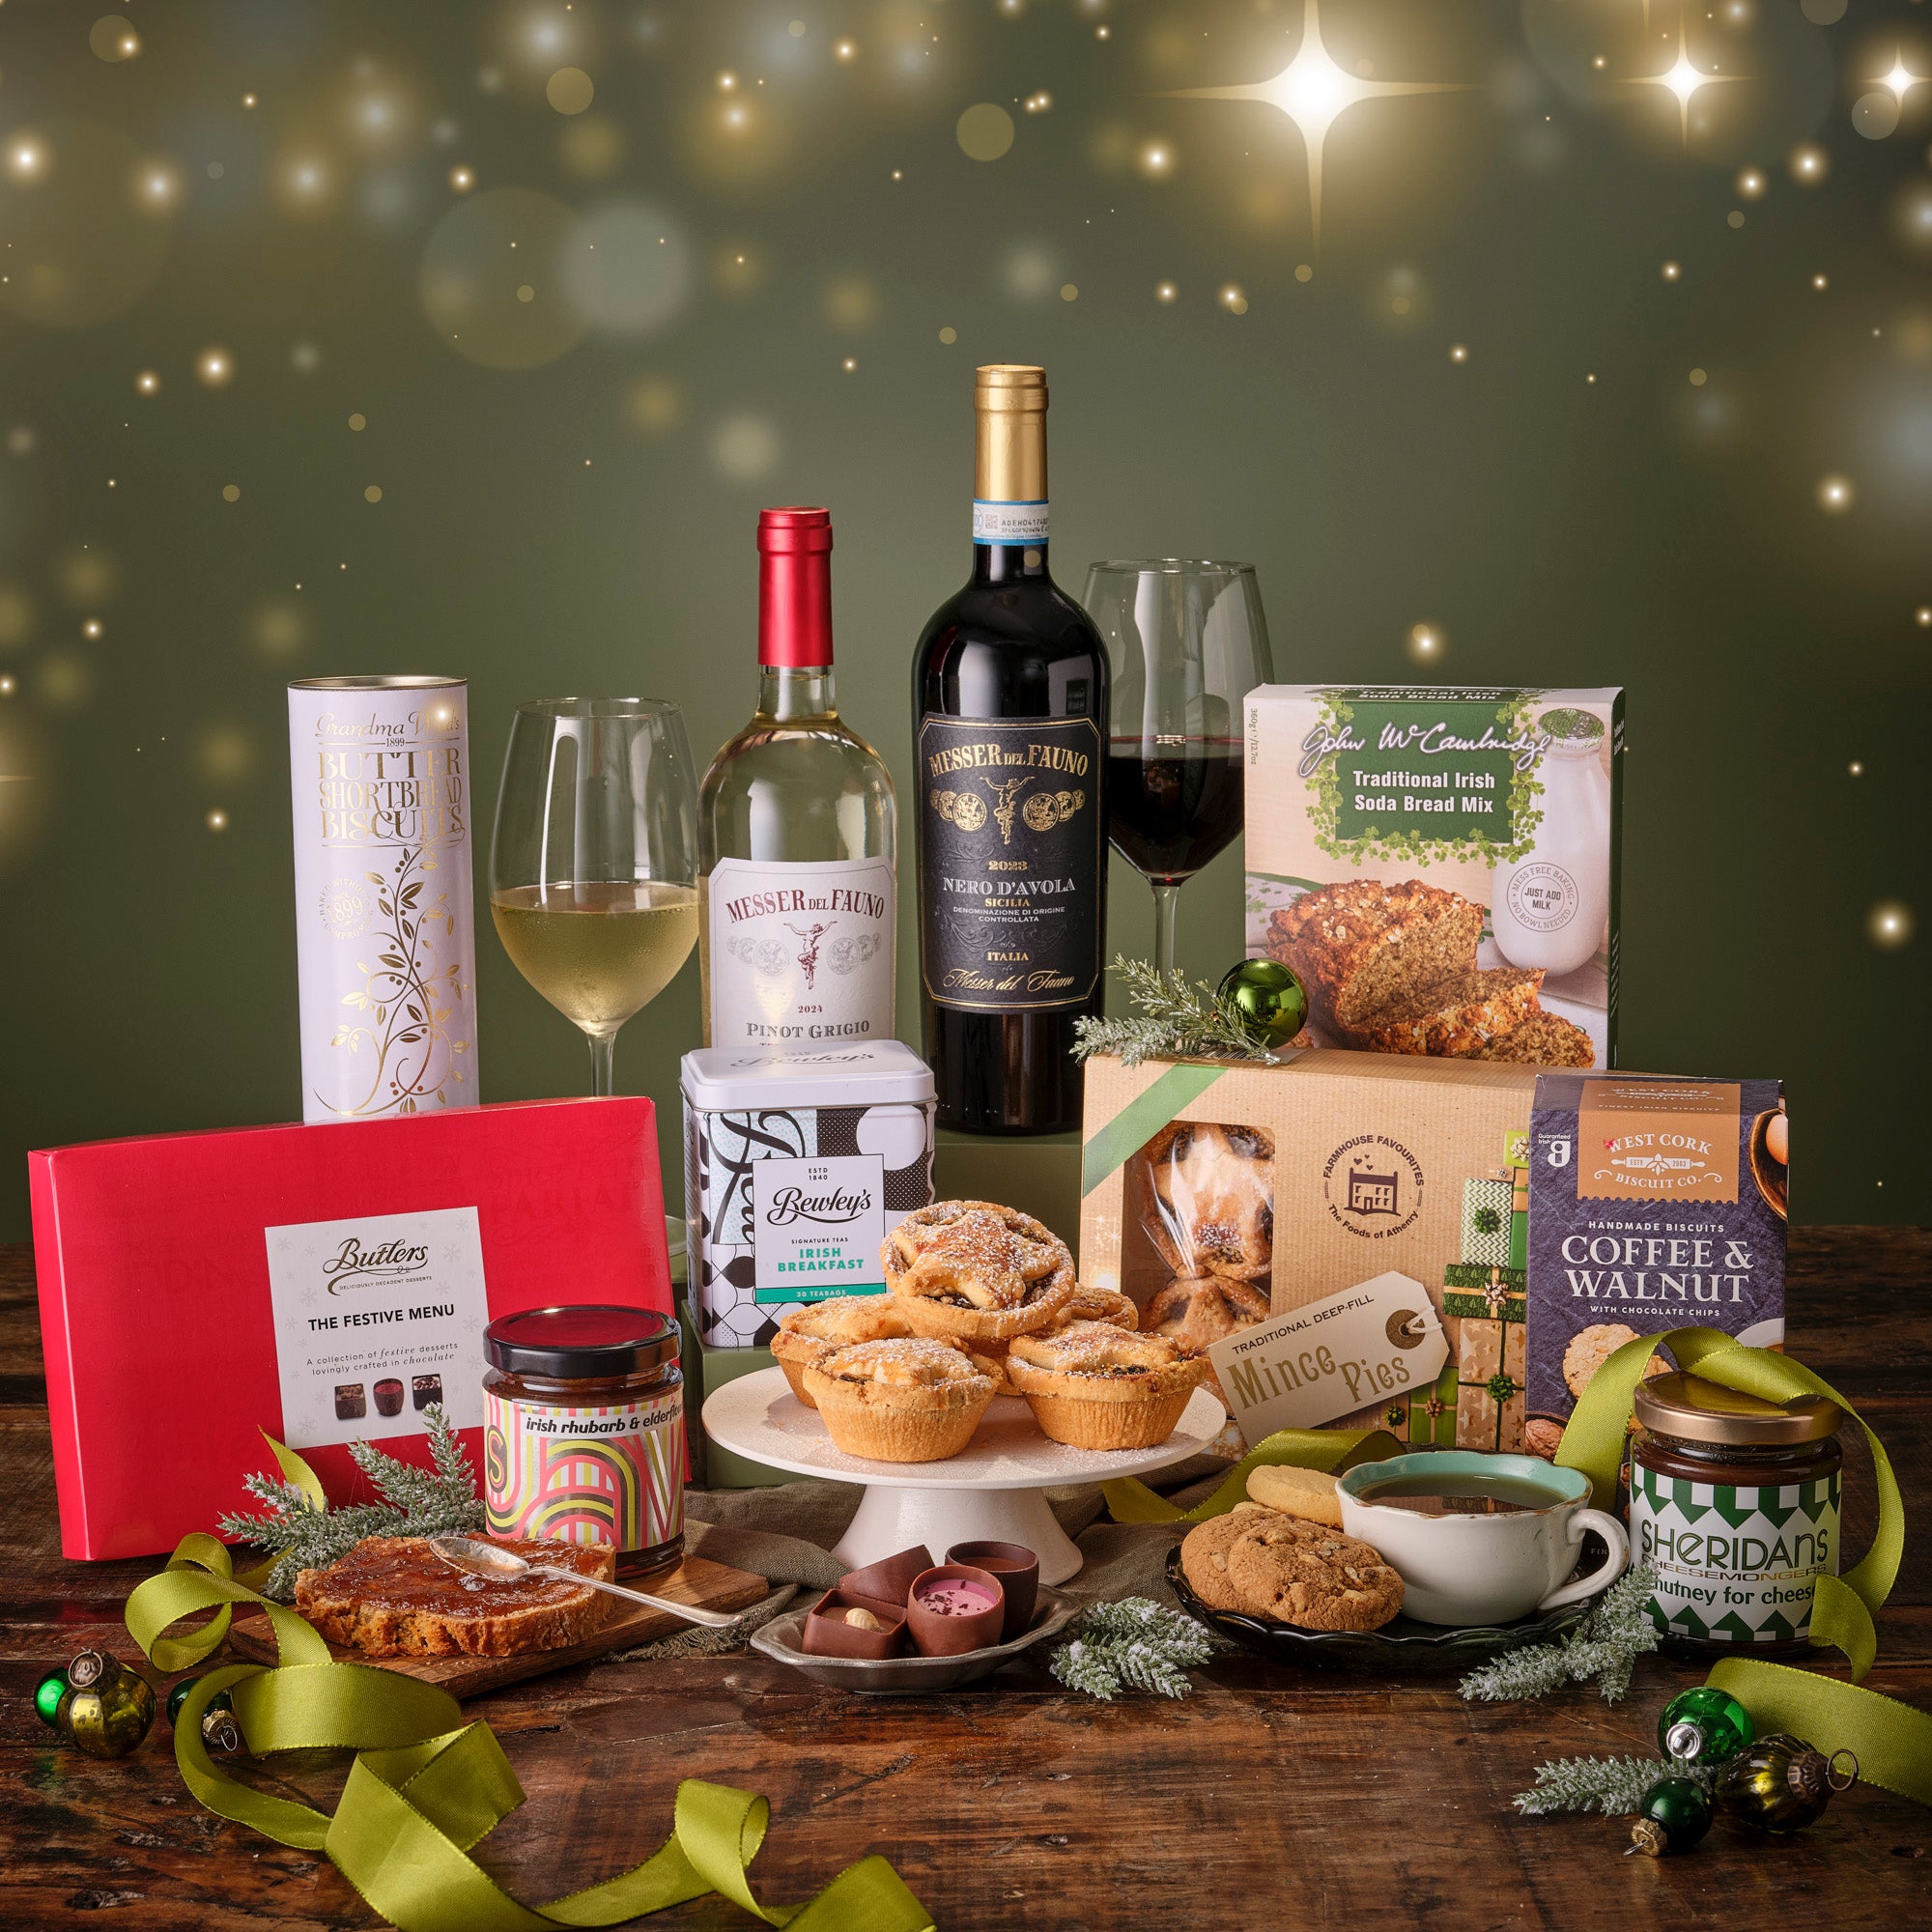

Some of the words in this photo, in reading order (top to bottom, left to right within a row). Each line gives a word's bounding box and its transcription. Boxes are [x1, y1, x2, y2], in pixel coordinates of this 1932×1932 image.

[315, 712, 405, 737] Grandma
[385, 737, 405, 748] 1899
[1299, 724, 1365, 777] John
[318, 748, 461, 780] BUTTER
[928, 743, 1003, 778] MESSER
[1004, 753, 1026, 766] DEL
[1026, 744, 1089, 777] FAUNO
[1352, 770, 1448, 788] Traditional
[1455, 772, 1495, 788] Irish
[319, 777, 462, 811] SHORTBREAD
[1354, 794, 1397, 811] Soda
[1404, 795, 1455, 812] Bread
[1462, 796, 1493, 812] Mix
[321, 806, 466, 840] BISCUITS
[988, 860, 1029, 871] 2023
[943, 877, 993, 895] NERO
[997, 877, 1076, 895] D'AVOLA
[1512, 870, 1529, 892] MESS
[1530, 867, 1552, 875] FREE
[1552, 870, 1575, 899] BAKING
[1524, 887, 1544, 898] JUST
[1546, 890, 1562, 901] ADD
[725, 889, 806, 923] MESSER
[808, 898, 829, 910] DEL
[830, 889, 885, 920] FAUNO
[952, 906, 1020, 916] DENOMINAZIONE
[1022, 907, 1031, 916] DI
[1033, 906, 1065, 915] ORIGINE
[984, 897, 1031, 907] SICILIA
[1532, 899, 1551, 911] MILK
[1512, 901, 1522, 914] NO
[1519, 914, 1543, 928] BOWL
[1543, 908, 1572, 929] NEEDED
[986, 952, 1029, 961] ITALIA
[943, 968, 995, 991] Messer
[995, 975, 1025, 991] del
[1027, 969, 1074, 992] Fauno
[798, 1005, 823, 1013] 2024
[746, 1022, 804, 1038] PINOT
[809, 1020, 870, 1038] GRIGIO
[1605, 1133, 1655, 1153] WEST
[1659, 1133, 1714, 1155] CORK
[1322, 1134, 1375, 1179] FARMHOUSE
[1377, 1135, 1425, 1187] FAVOURITES
[1615, 1172, 1674, 1189] BISCUIT
[766, 1186, 871, 1226] Bewley's
[1328, 1204, 1342, 1222] The
[1342, 1220, 1371, 1238] Foods
[1373, 1230, 1384, 1239] of
[1386, 1209, 1419, 1237] Athenry
[1588, 1220, 1660, 1231] HANDMADE
[1665, 1223, 1724, 1233] BISCUITS
[323, 1237, 428, 1277] Butlers
[799, 1247, 841, 1259] IRISH
[1561, 1236, 1714, 1267] COFFEE
[1724, 1240, 1754, 1269] &
[778, 1259, 864, 1272] BREAKFAST
[339, 1282, 374, 1291] DELICIOUSLY
[406, 1275, 432, 1284] DESSERTS
[1563, 1269, 1749, 1303] WALNUT
[308, 1317, 338, 1331] THE
[343, 1310, 404, 1327] FESTIVE
[409, 1304, 455, 1321] MENU
[1590, 1305, 1617, 1314] WITH
[1622, 1307, 1684, 1316] CHOCOLATE
[1232, 1320, 1312, 1354] TRADITIONAL
[1313, 1294, 1375, 1324] DEEP-FILL
[312, 1365, 350, 1376] lovingly
[354, 1360, 387, 1371] crafted
[403, 1352, 455, 1366] chocolate
[317, 1353, 364, 1365] collection
[380, 1348, 415, 1360] festive
[419, 1343, 458, 1353] desserts
[1225, 1345, 1336, 1409] Mince
[1338, 1356, 1410, 1404] Pies
[526, 1417, 557, 1433] irish
[560, 1418, 626, 1434] rhubarb
[629, 1417, 640, 1430] &
[1655, 1576, 1718, 1605] hutney
[1723, 1586, 1754, 1605] for
[1761, 1584, 1816, 1605] chees
